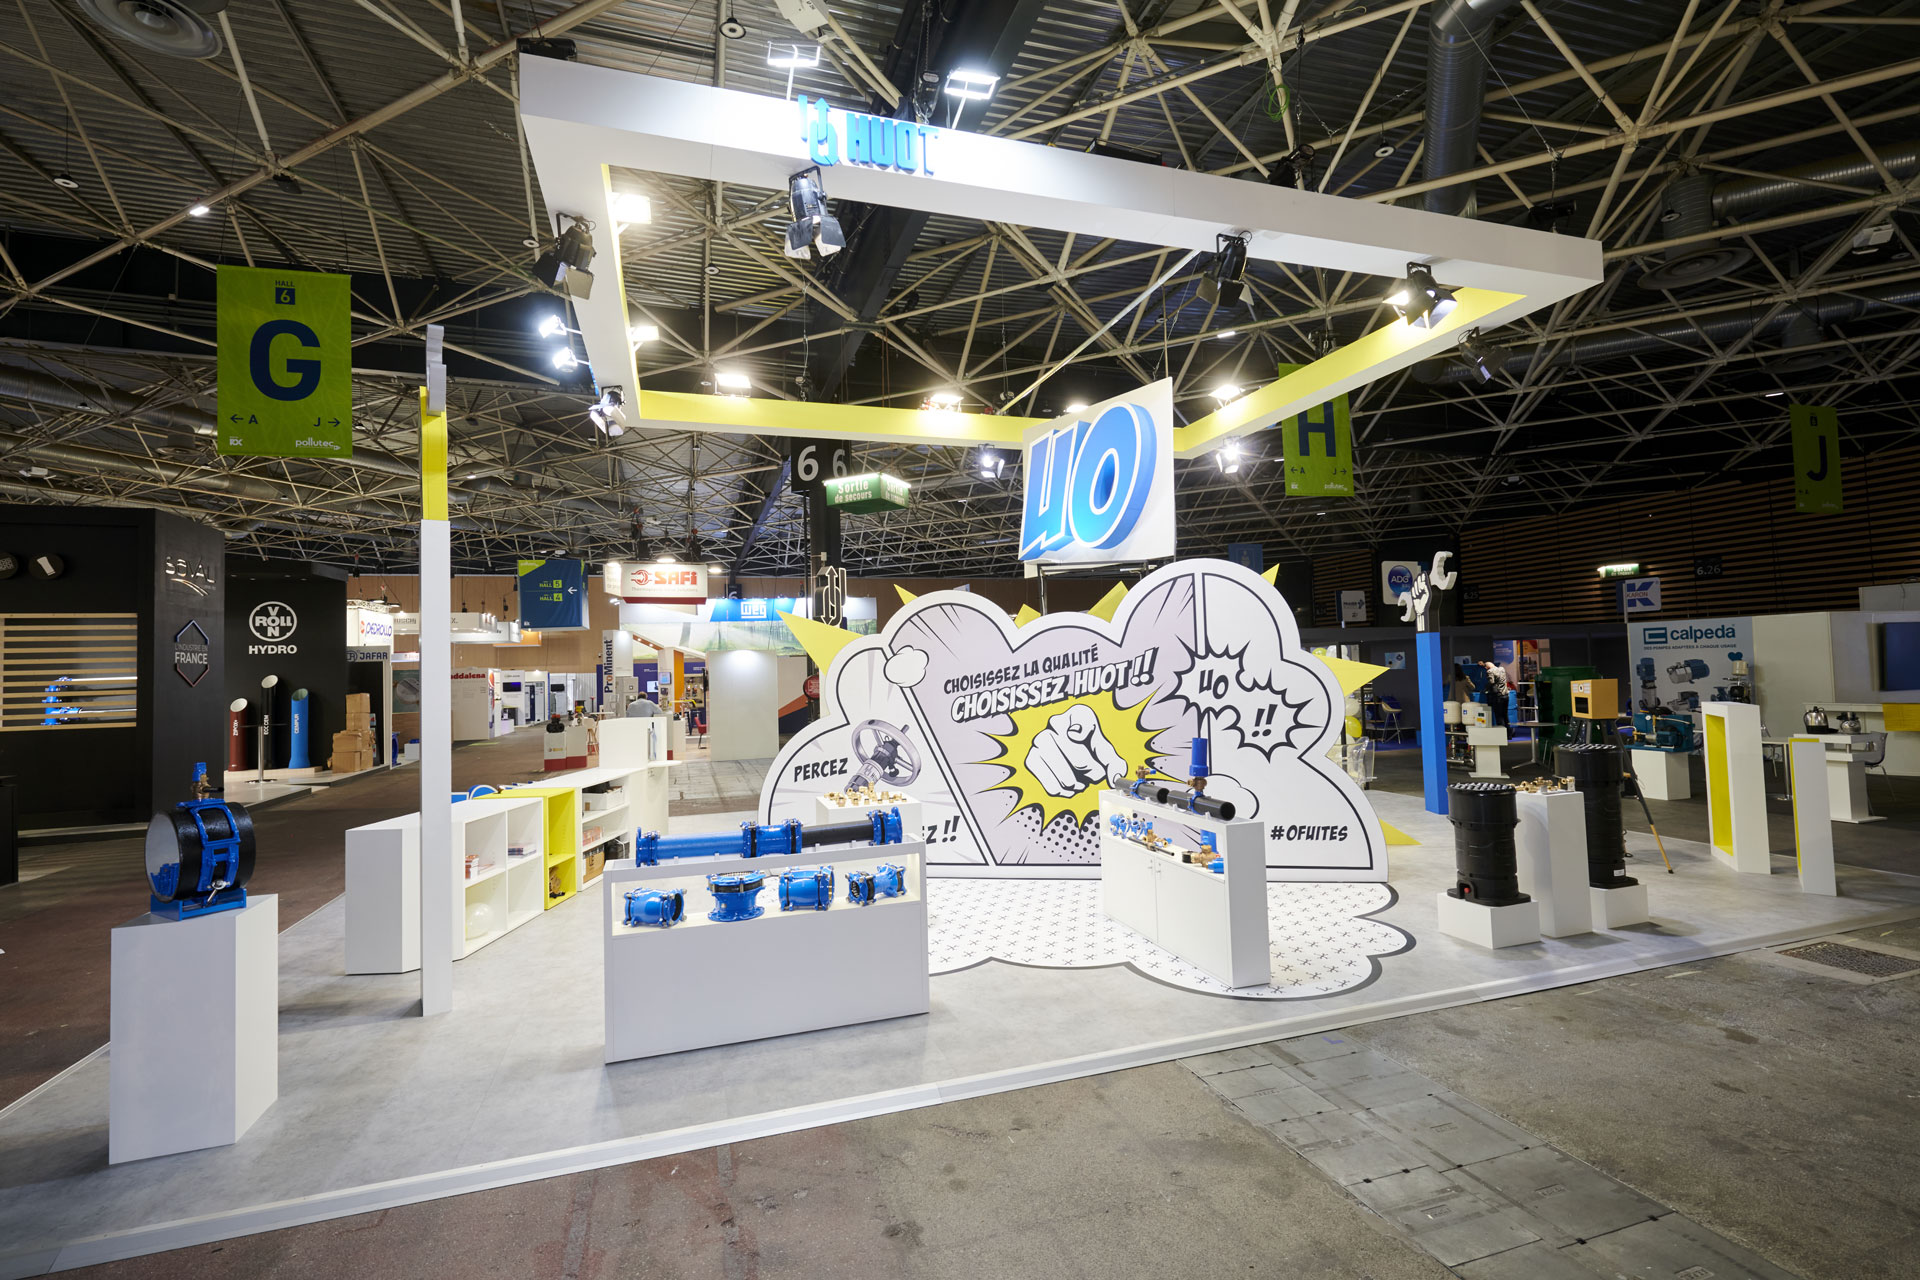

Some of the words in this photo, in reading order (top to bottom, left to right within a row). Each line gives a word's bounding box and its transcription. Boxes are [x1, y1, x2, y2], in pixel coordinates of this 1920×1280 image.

[847, 112, 940, 176] HUOT
[280, 289, 291, 304] 6
[249, 319, 321, 402] G
[248, 414, 259, 425] A
[313, 417, 321, 427] J
[1297, 401, 1337, 458] H
[295, 437, 335, 448] pollutec
[797, 445, 819, 482] 6
[832, 448, 848, 479] 6
[1806, 435, 1828, 481] J
[834, 493, 845, 503] de
[845, 490, 873, 502] secours
[838, 480, 869, 494] Sortie
[1390, 575, 1409, 583] ADG
[1696, 565, 1721, 576] 6.26
[1670, 624, 1736, 643] calpeda
[175, 651, 208, 665] FRANCE
[248, 645, 298, 655] HYDRO
[359, 652, 388, 661] JAFAR
[604, 640, 613, 693] ProMinent
[944, 664, 1021, 694] CHOISISSEZ
[1024, 659, 1040, 678] LA
[1042, 643, 1099, 673] QUALITÉ
[951, 674, 1070, 724] CHOISISSEZ
[1073, 659, 1133, 699] HUOT
[1251, 704, 1278, 738] !!
[793, 757, 849, 783] PERCEZ
[942, 815, 961, 843] !!
